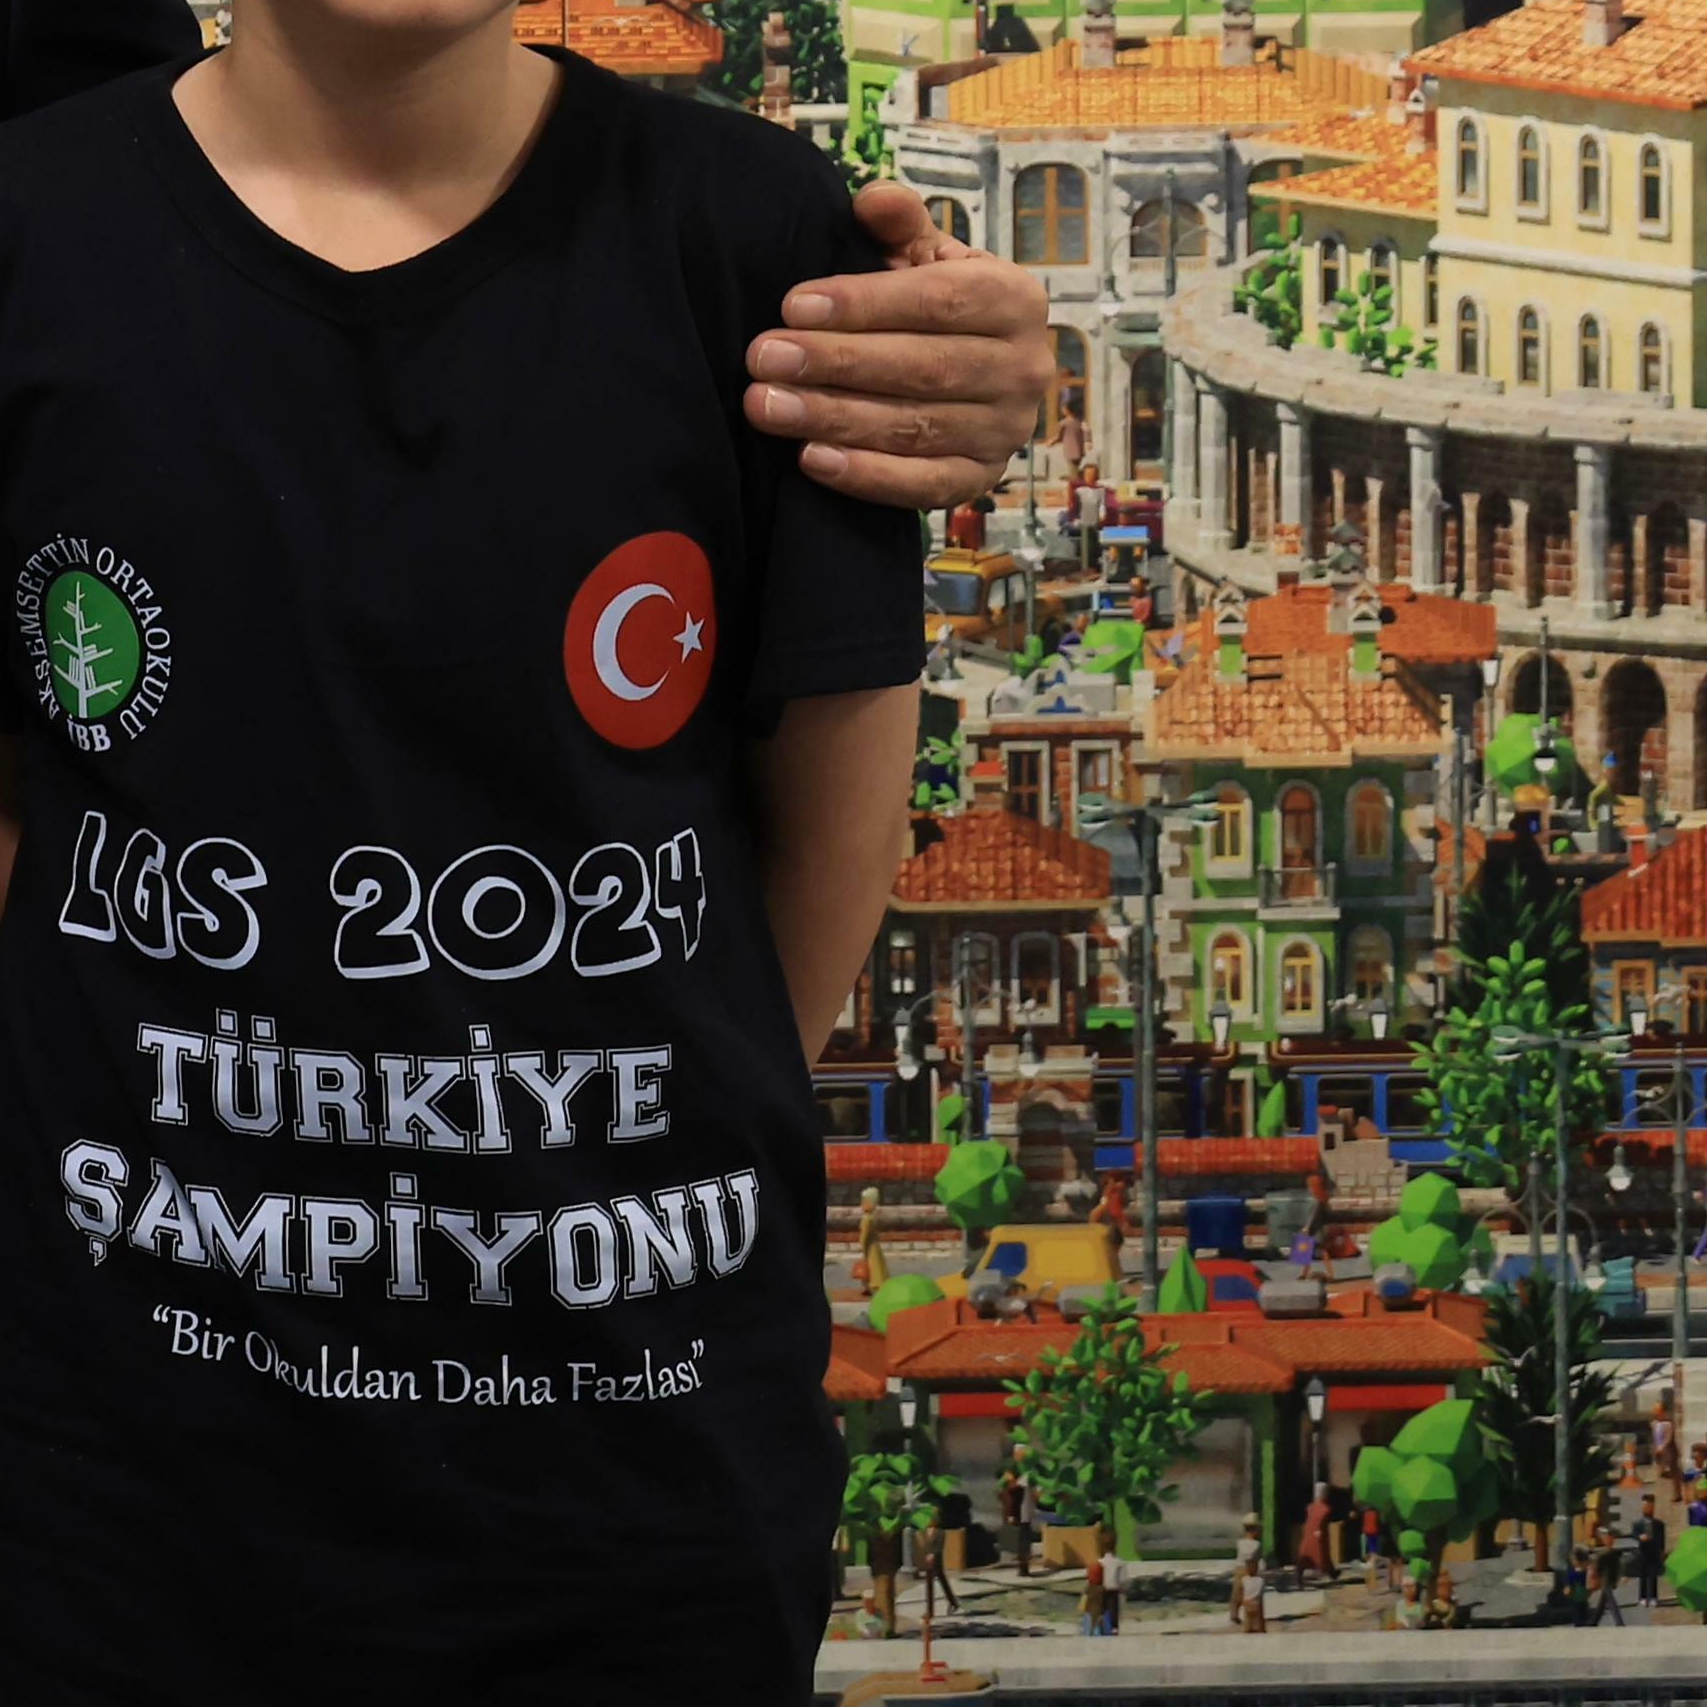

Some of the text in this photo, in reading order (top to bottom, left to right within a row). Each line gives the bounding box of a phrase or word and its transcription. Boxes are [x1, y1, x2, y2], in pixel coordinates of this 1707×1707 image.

[96, 546, 172, 740] ORTAOKULU
[59, 811, 706, 980] LGS 2024
[137, 1008, 671, 1154] TÜRKİYE
[61, 1138, 760, 1310] ŞAMPİYONU
[246, 1332, 421, 1400] Okuldan
[432, 1355, 556, 1405] Daha
